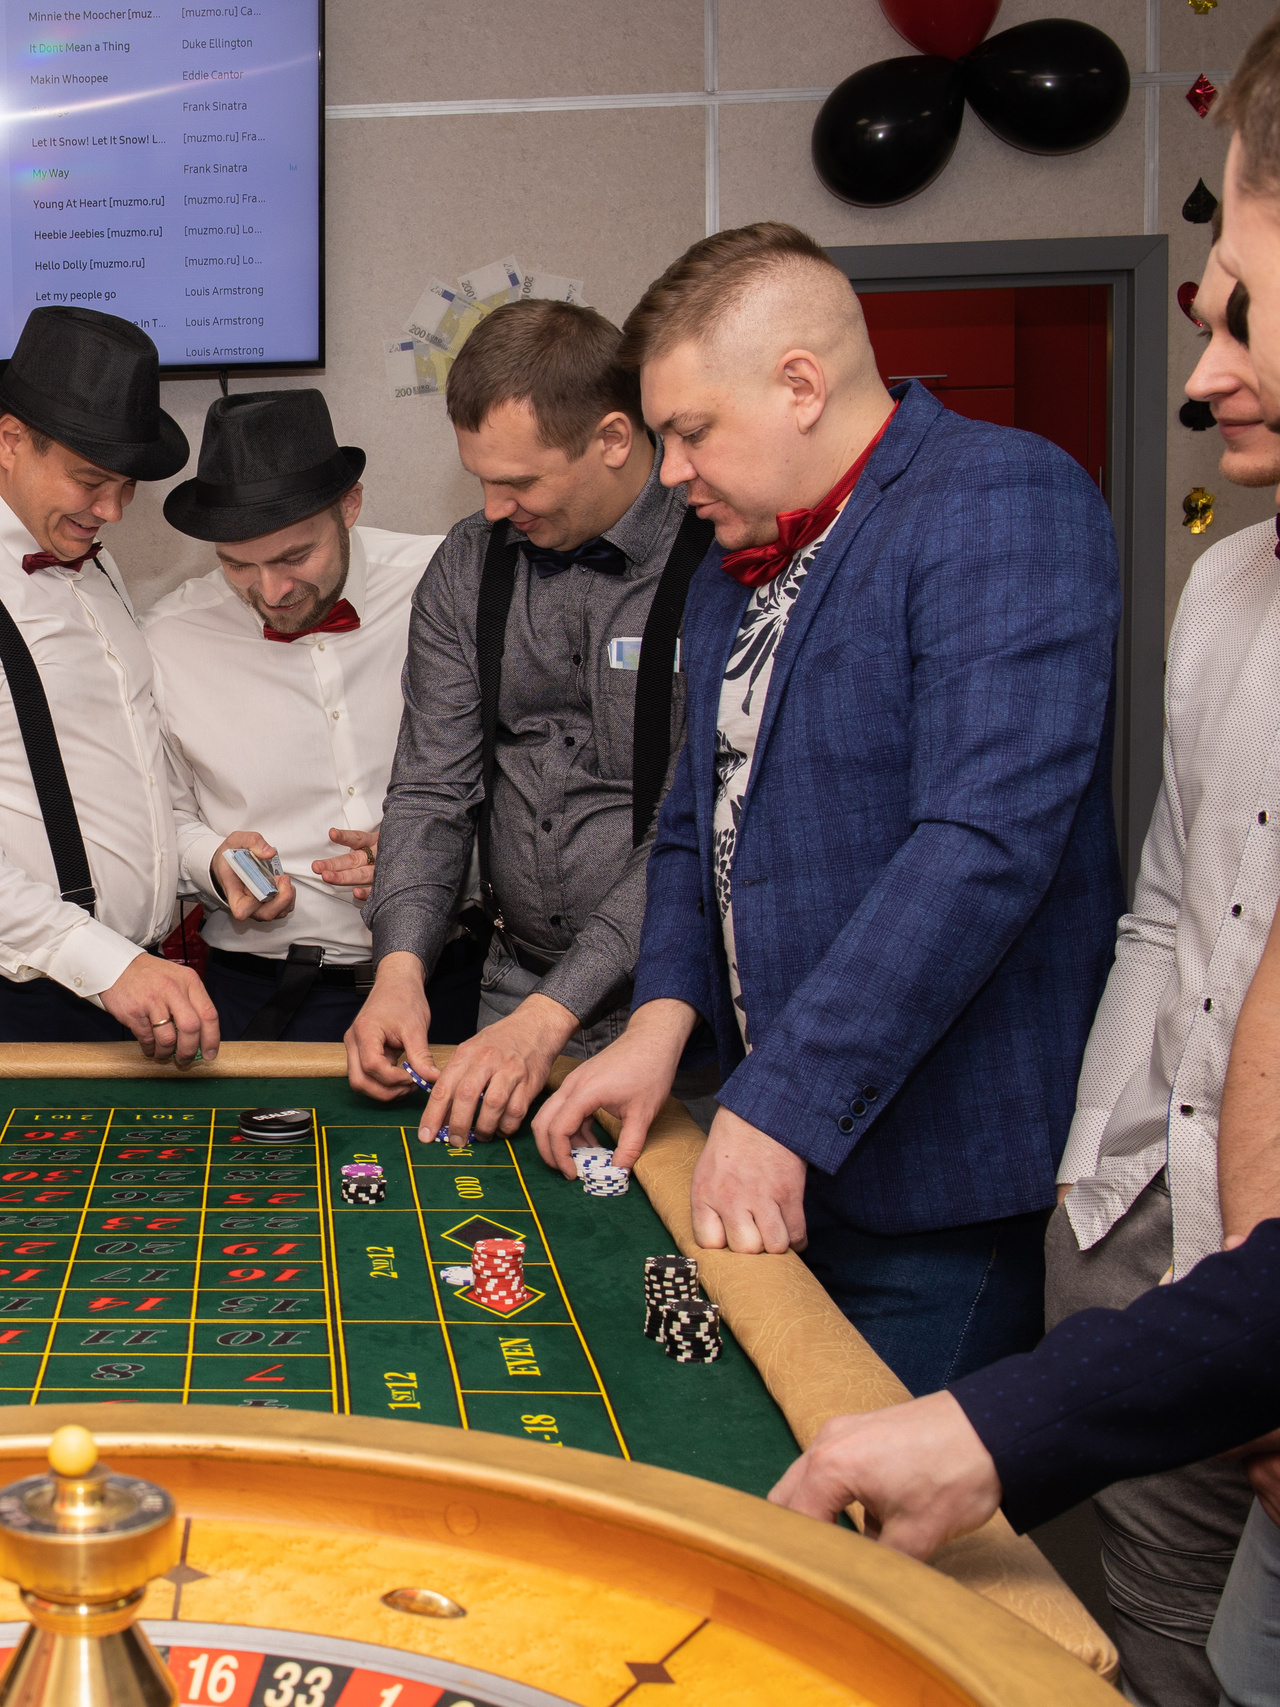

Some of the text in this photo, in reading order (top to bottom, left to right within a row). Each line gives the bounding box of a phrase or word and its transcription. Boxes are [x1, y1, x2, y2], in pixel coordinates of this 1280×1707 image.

[29, 11, 62, 21] Minnie
[64, 11, 80, 20] the
[83, 10, 126, 20] Moocher
[182, 6, 238, 18] [muzmo.ru]
[29, 44, 37, 53] It
[40, 43, 63, 53] Dont
[65, 43, 92, 52] Mean
[103, 41, 130, 53] Thing
[182, 39, 253, 50] Duke Ellington
[30, 74, 109, 85] Makin Whoopee
[183, 70, 244, 80] Eddie Cantor
[183, 101, 247, 111] Frank Sinatra
[32, 138, 47, 147] Let
[50, 138, 57, 146] It
[59, 137, 89, 146] Snow!
[92, 136, 107, 145] Let
[110, 136, 117, 145] It
[119, 135, 149, 144] Snow!
[183, 132, 239, 144] [muzmo.ru]
[33, 168, 69, 180] My Way
[183, 163, 248, 173] Frank Sinatra
[33, 196, 165, 210] Young At Heart [muzmo.ru]
[184, 194, 239, 206] [muzmo.ru]
[34, 227, 162, 240] Heebie Jeebies [muzmo.ru]
[184, 224, 240, 236] [muzmo.ru]
[35, 258, 145, 271] Hello Dolly [muzmo.ru]
[184, 255, 240, 267] [muzmo.ru]
[461, 279, 475, 298] 200
[522, 275, 534, 294] 200
[35, 290, 116, 302] Let my people go
[185, 286, 264, 297] Louis Armstrong
[141, 319, 150, 328] In
[185, 316, 264, 327] Louis Armstrong
[408, 324, 427, 340] 200
[185, 346, 264, 357] Louis Armstrong
[395, 387, 413, 398] 200
[16, 1130, 97, 1141] 36
[121, 1130, 200, 1141] 35
[8, 1149, 91, 1160] 33
[117, 1148, 195, 1159] 32
[229, 1149, 303, 1161] 31
[1, 1169, 83, 1182] 30
[110, 1169, 196, 1182] 29
[223, 1170, 306, 1181] 28
[454, 1176, 484, 1199] ODD
[103, 1191, 194, 1204] 26
[223, 1192, 306, 1204] 25
[100, 1216, 187, 1230] 23
[220, 1216, 308, 1229] 22
[94, 1241, 185, 1254] 20
[222, 1241, 306, 1255] 19
[90, 1267, 179, 1283] 17
[218, 1268, 308, 1283] 16
[87, 1297, 173, 1313] 14
[218, 1296, 309, 1313] 13
[80, 1329, 167, 1345] 11
[217, 1330, 310, 1346] 10
[498, 1336, 541, 1377] EVEN
[91, 1363, 145, 1380] 8
[243, 1364, 285, 1381] 7
[521, 1414, 563, 1447] -18
[187, 1652, 239, 1704] 16
[262, 1661, 333, 1707] 33
